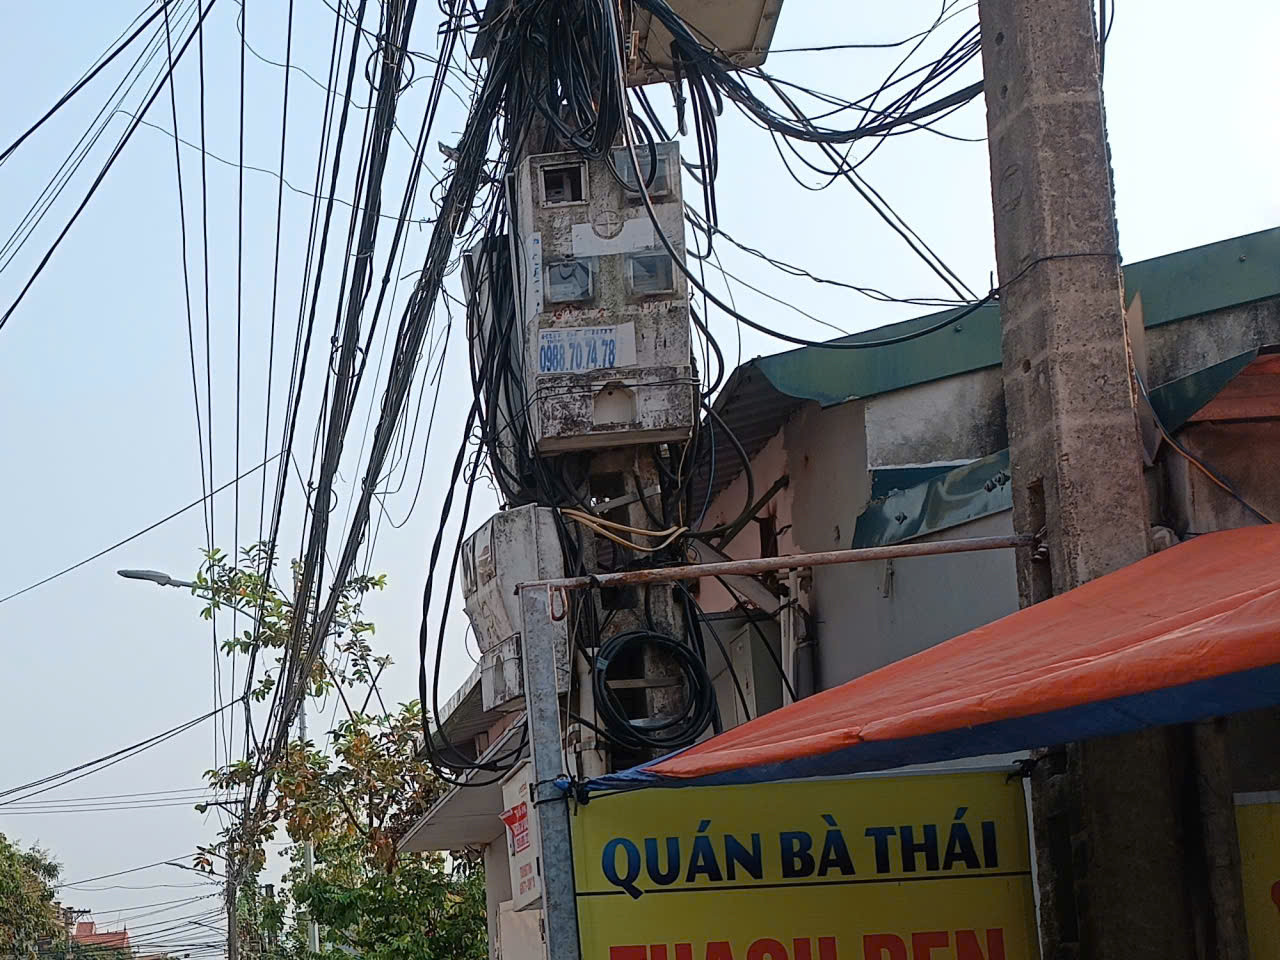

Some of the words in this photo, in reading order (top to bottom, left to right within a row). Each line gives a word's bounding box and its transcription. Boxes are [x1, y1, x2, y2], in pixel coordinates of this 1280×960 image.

[602, 819, 763, 899] QUÁN
[779, 814, 856, 878] BÀ
[865, 807, 999, 873] THÁI
